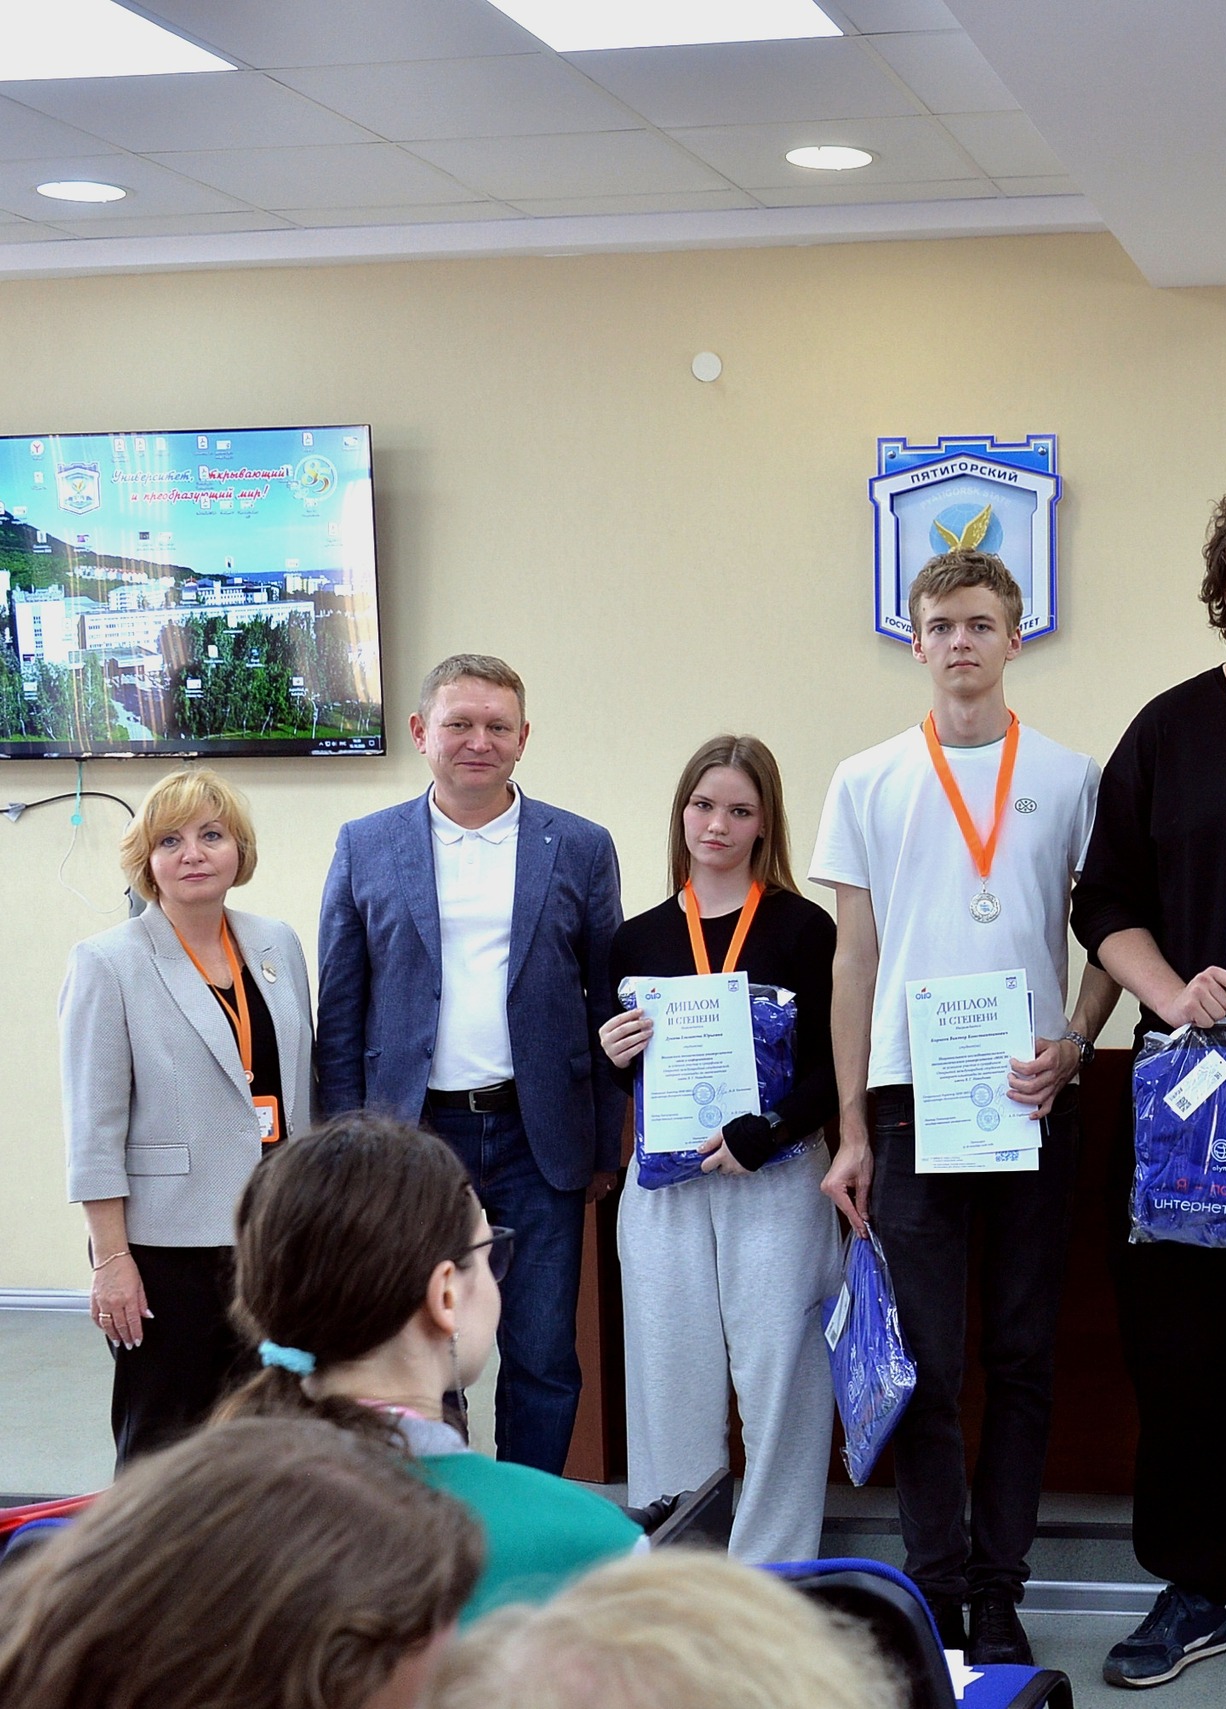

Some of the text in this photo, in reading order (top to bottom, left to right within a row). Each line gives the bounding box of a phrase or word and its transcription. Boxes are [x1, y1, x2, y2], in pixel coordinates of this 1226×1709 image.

[206, 468, 286, 484] ткрывающий
[910, 462, 1019, 484] ПЯТИГОРСКИЙ
[237, 485, 270, 502] мир!
[666, 999, 720, 1015] ДИПЛОМ
[936, 997, 998, 1016] ДИПЛОМ
[675, 1013, 720, 1025] СТЕПЕНИ
[949, 1012, 998, 1026] СТЕПЕНИ
[1176, 1178, 1188, 1190] Я
